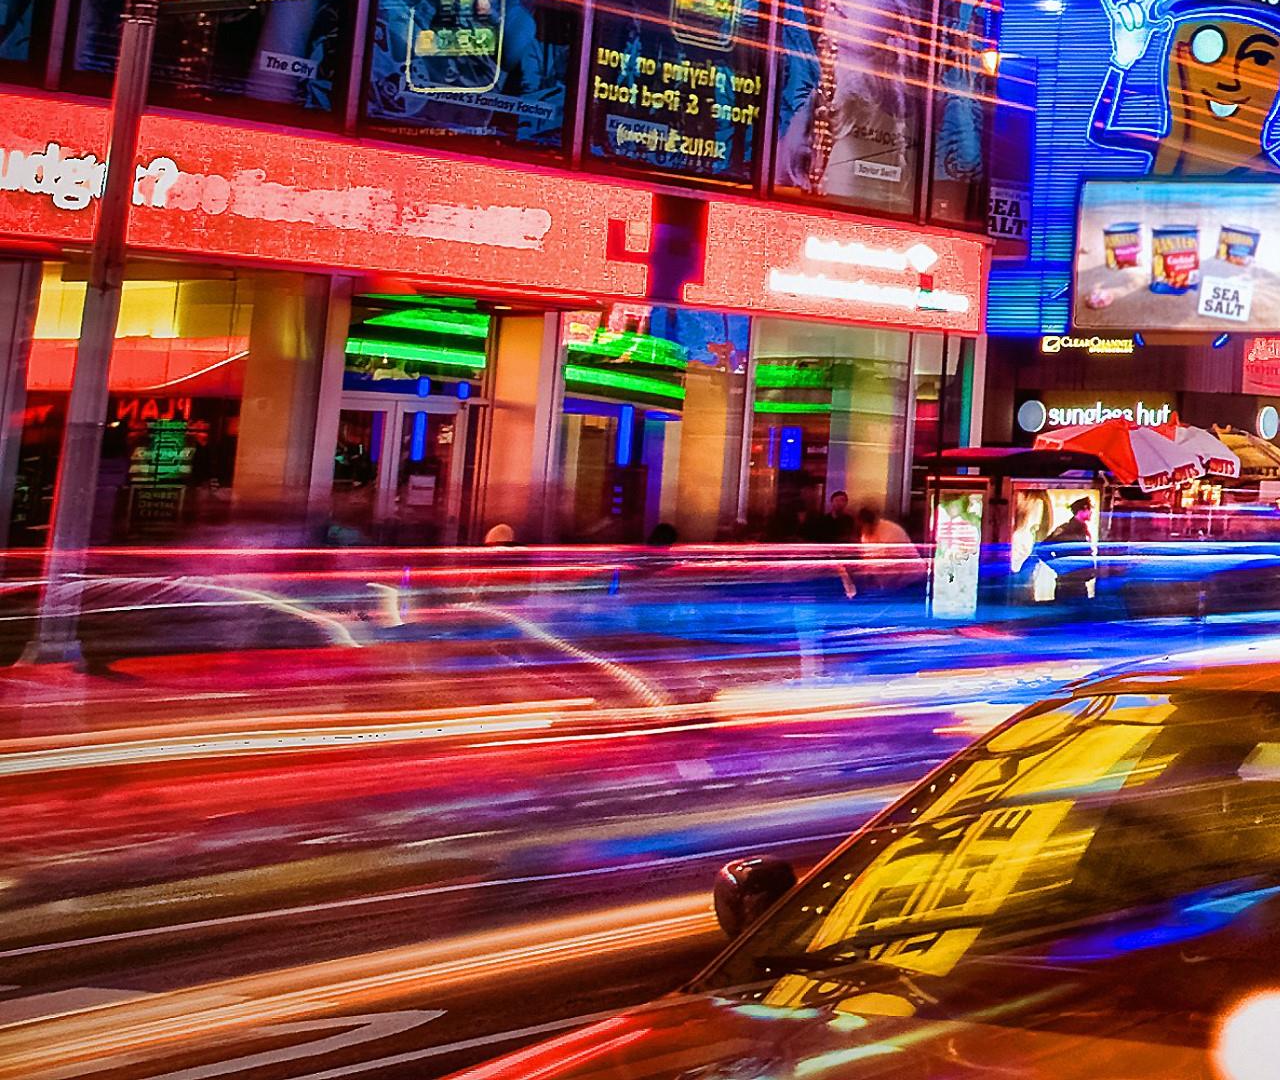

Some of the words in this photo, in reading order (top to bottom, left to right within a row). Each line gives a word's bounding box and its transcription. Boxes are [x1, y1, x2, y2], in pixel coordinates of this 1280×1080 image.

[265, 56, 289, 71] The
[291, 59, 315, 78] City
[474, 92, 515, 114] Fantasy
[516, 100, 554, 121] Factory
[988, 219, 1028, 237] ALT
[1212, 286, 1240, 304] SEA
[1204, 299, 1245, 318] SALT
[1048, 401, 1134, 426] sunglass
[1137, 401, 1172, 427] hut
